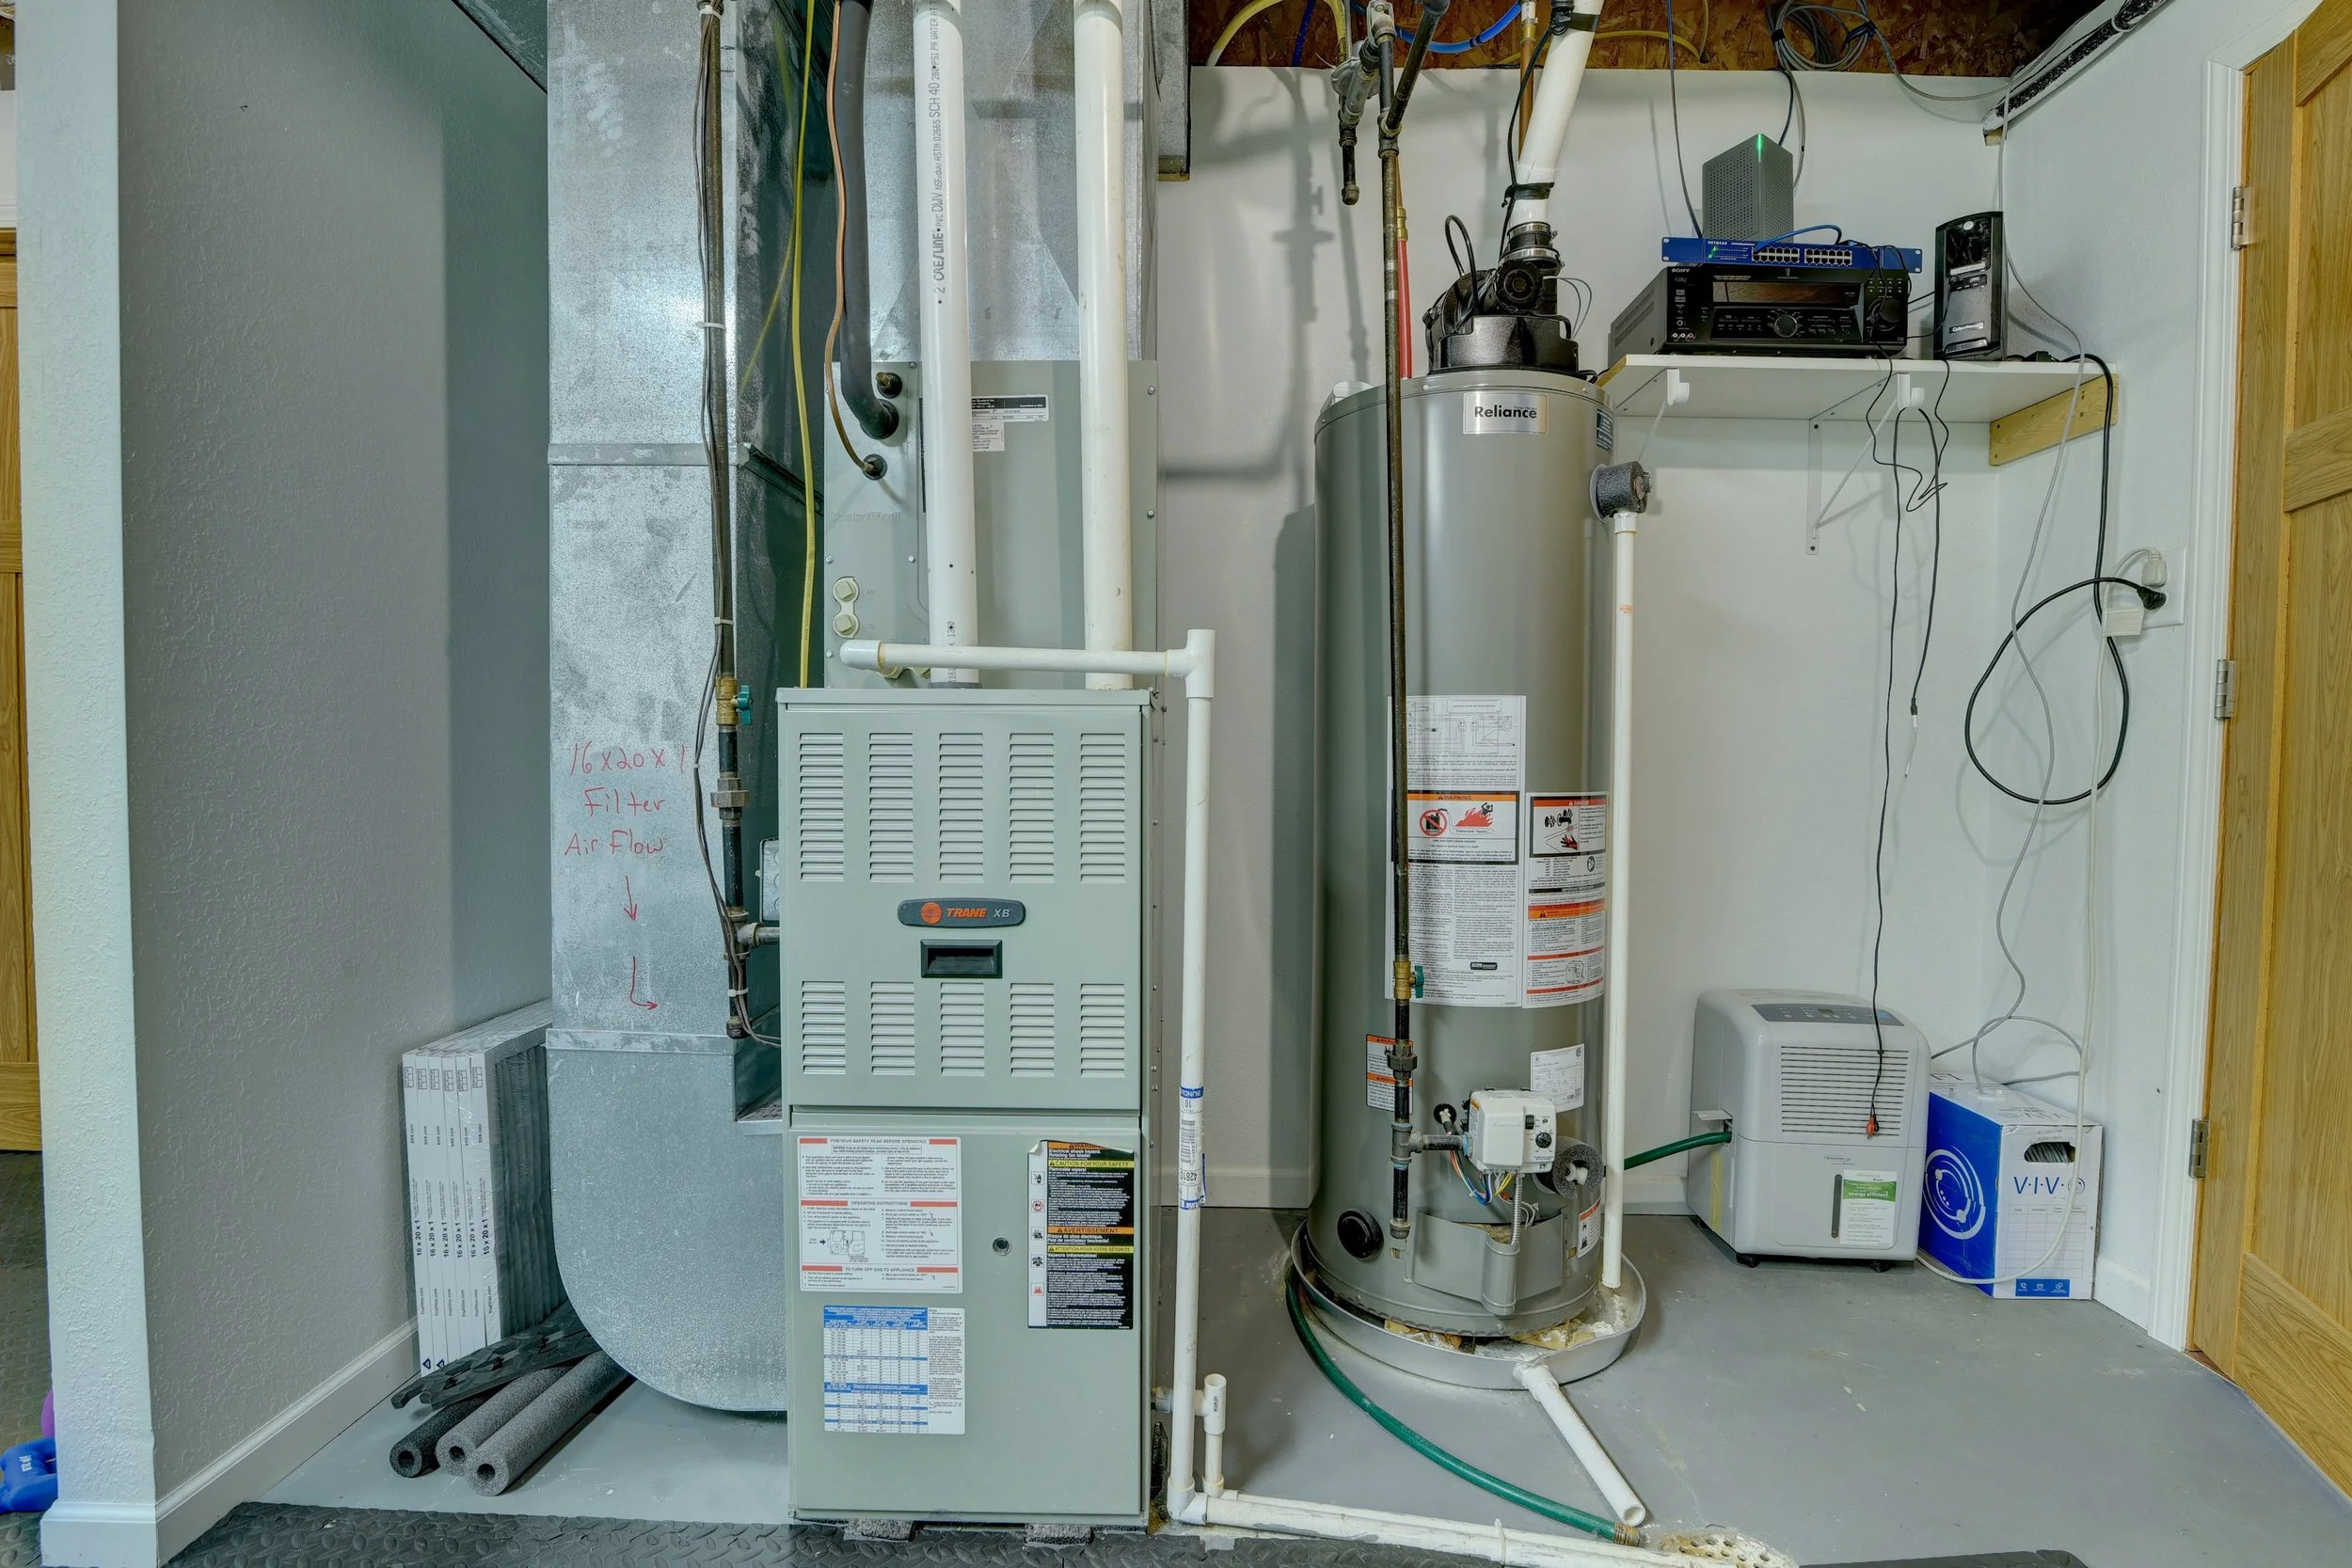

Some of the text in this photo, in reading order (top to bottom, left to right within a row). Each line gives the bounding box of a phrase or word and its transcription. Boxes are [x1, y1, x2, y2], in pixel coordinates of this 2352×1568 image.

[930, 18, 939, 40] WATER
[929, 83, 940, 95] 40
[929, 98, 941, 118] SCH
[933, 144, 942, 162] ASTM
[931, 192, 943, 213] DWV
[1474, 404, 1536, 419] Reliance
[583, 787, 666, 816] Filter
[564, 828, 664, 856] Air Flow
[946, 908, 1010, 918] TRANE XB
[415, 1231, 421, 1240] 20
[429, 1233, 435, 1242] 20
[443, 1233, 449, 1242] 20
[430, 1248, 436, 1257] 16
[443, 1249, 449, 1258] 16
[457, 1250, 463, 1259] 16
